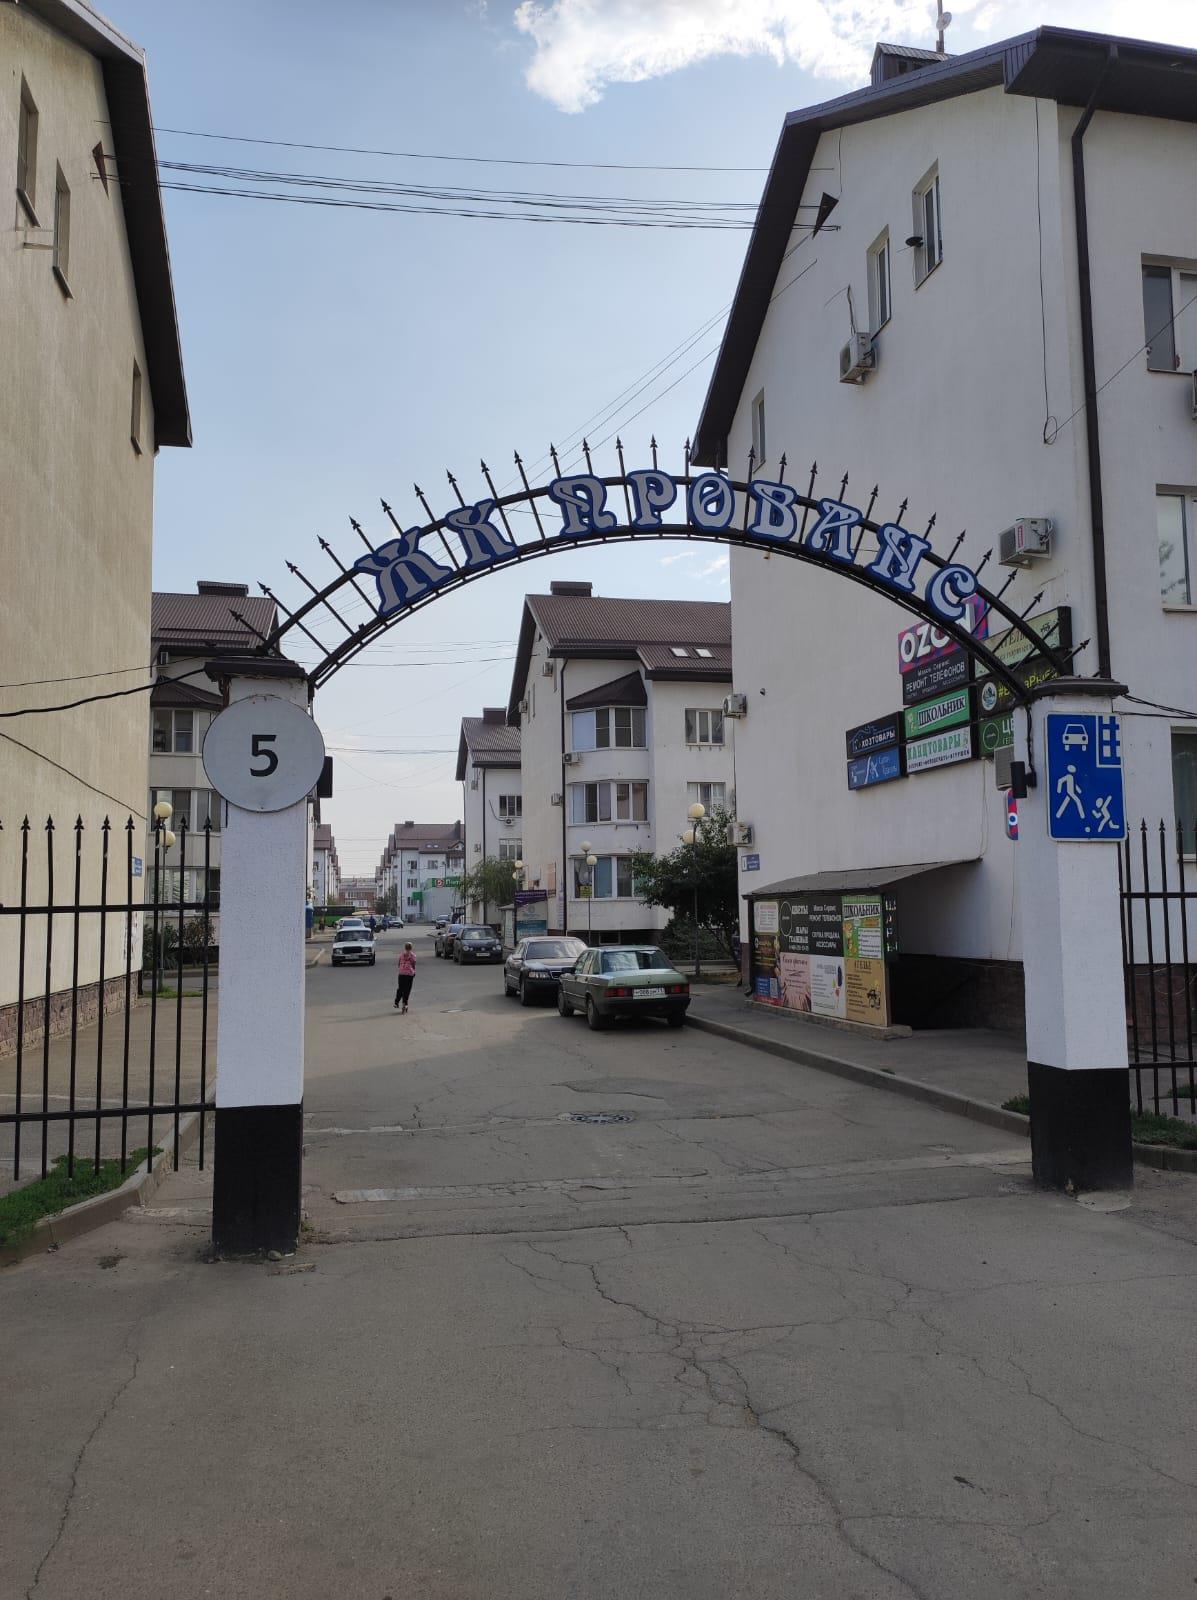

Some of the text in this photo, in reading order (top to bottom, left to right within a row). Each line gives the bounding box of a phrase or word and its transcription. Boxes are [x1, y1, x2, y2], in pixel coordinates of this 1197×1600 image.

[354, 469, 979, 621] ЖК ПРОВАНС
[906, 661, 965, 692] РЕМОНТ ТЕЛЕФОНОВ
[918, 697, 965, 726] ШКОЛЬНИК
[861, 730, 896, 748] ХОЗТОВАРЫ
[907, 734, 961, 761] КАНЦТОВАРЫ
[250, 735, 278, 777] 5
[844, 904, 880, 918] ШКОЛЬНИК
